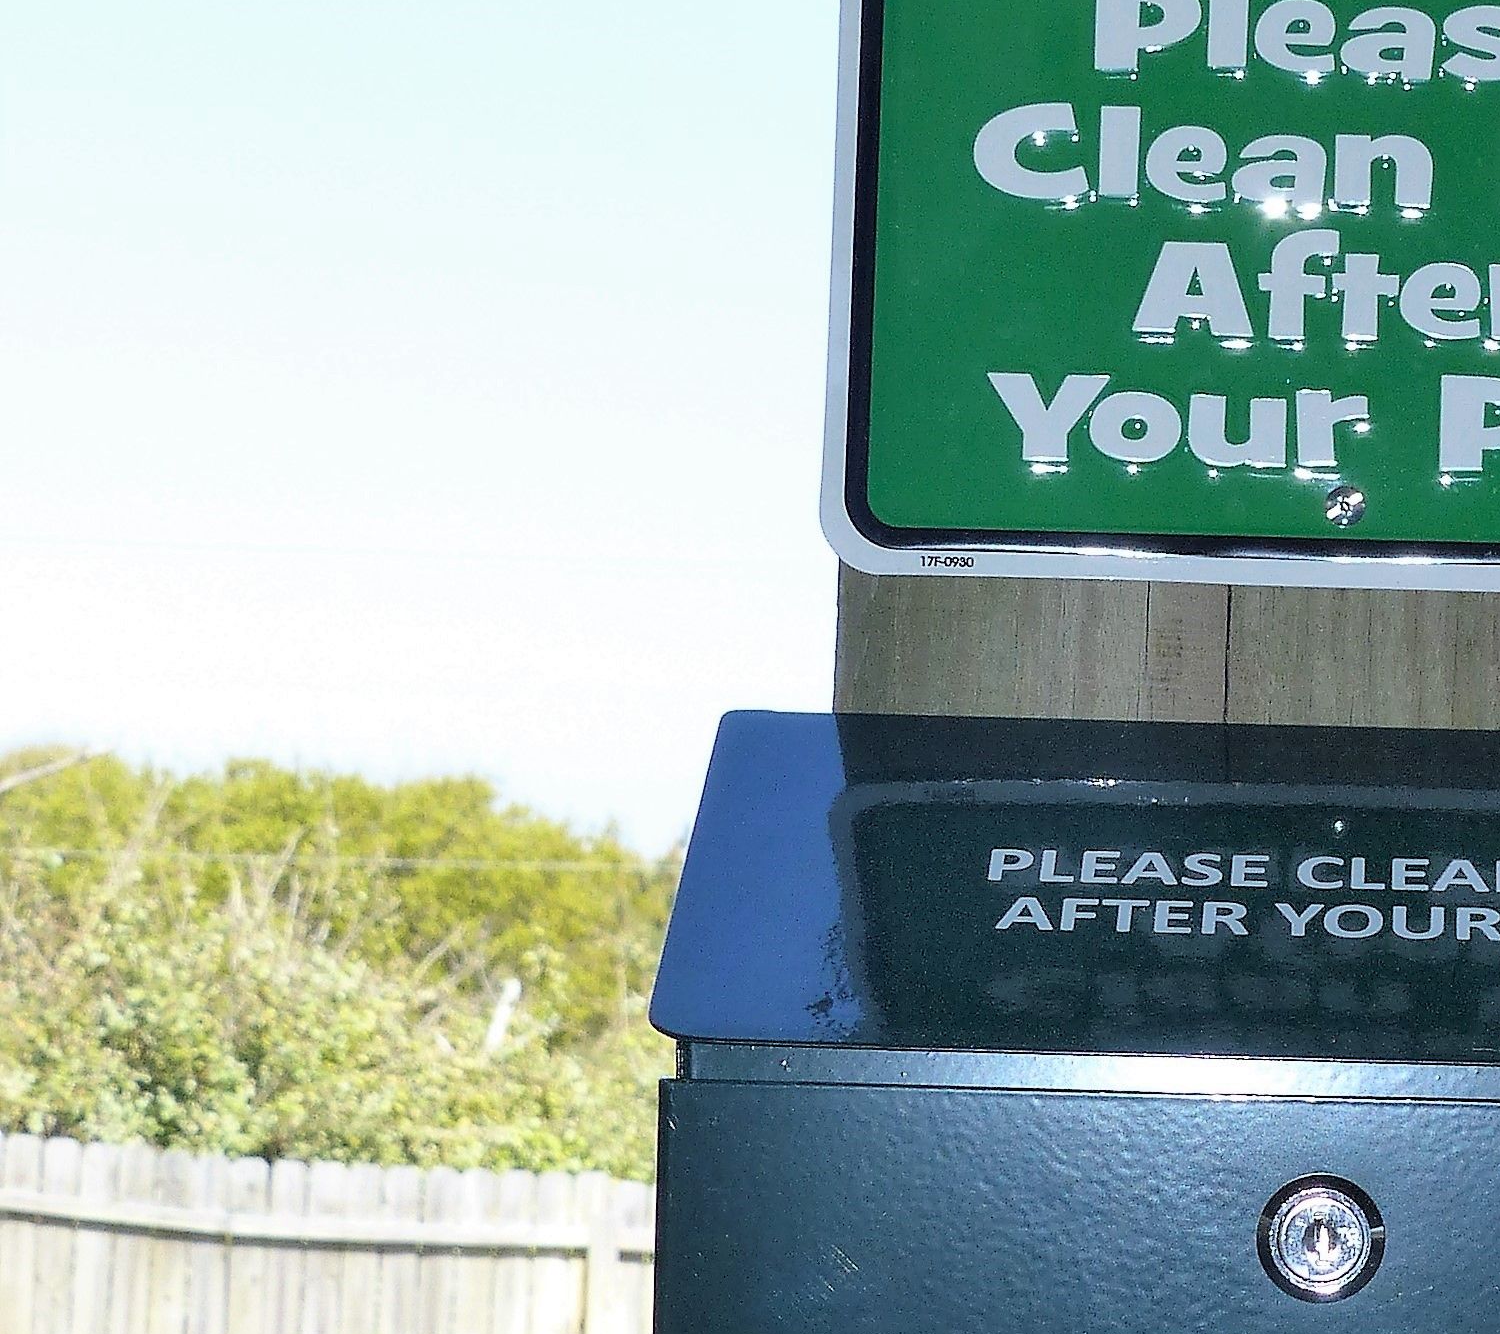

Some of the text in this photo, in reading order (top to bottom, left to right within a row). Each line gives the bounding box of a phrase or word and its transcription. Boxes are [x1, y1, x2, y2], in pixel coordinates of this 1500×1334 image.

[974, 103, 1433, 213] Clean
[987, 373, 1370, 468] Your
[921, 556, 974, 567] 17F-0930
[988, 849, 1269, 887] PLEASE
[995, 897, 1248, 935] AFTER
